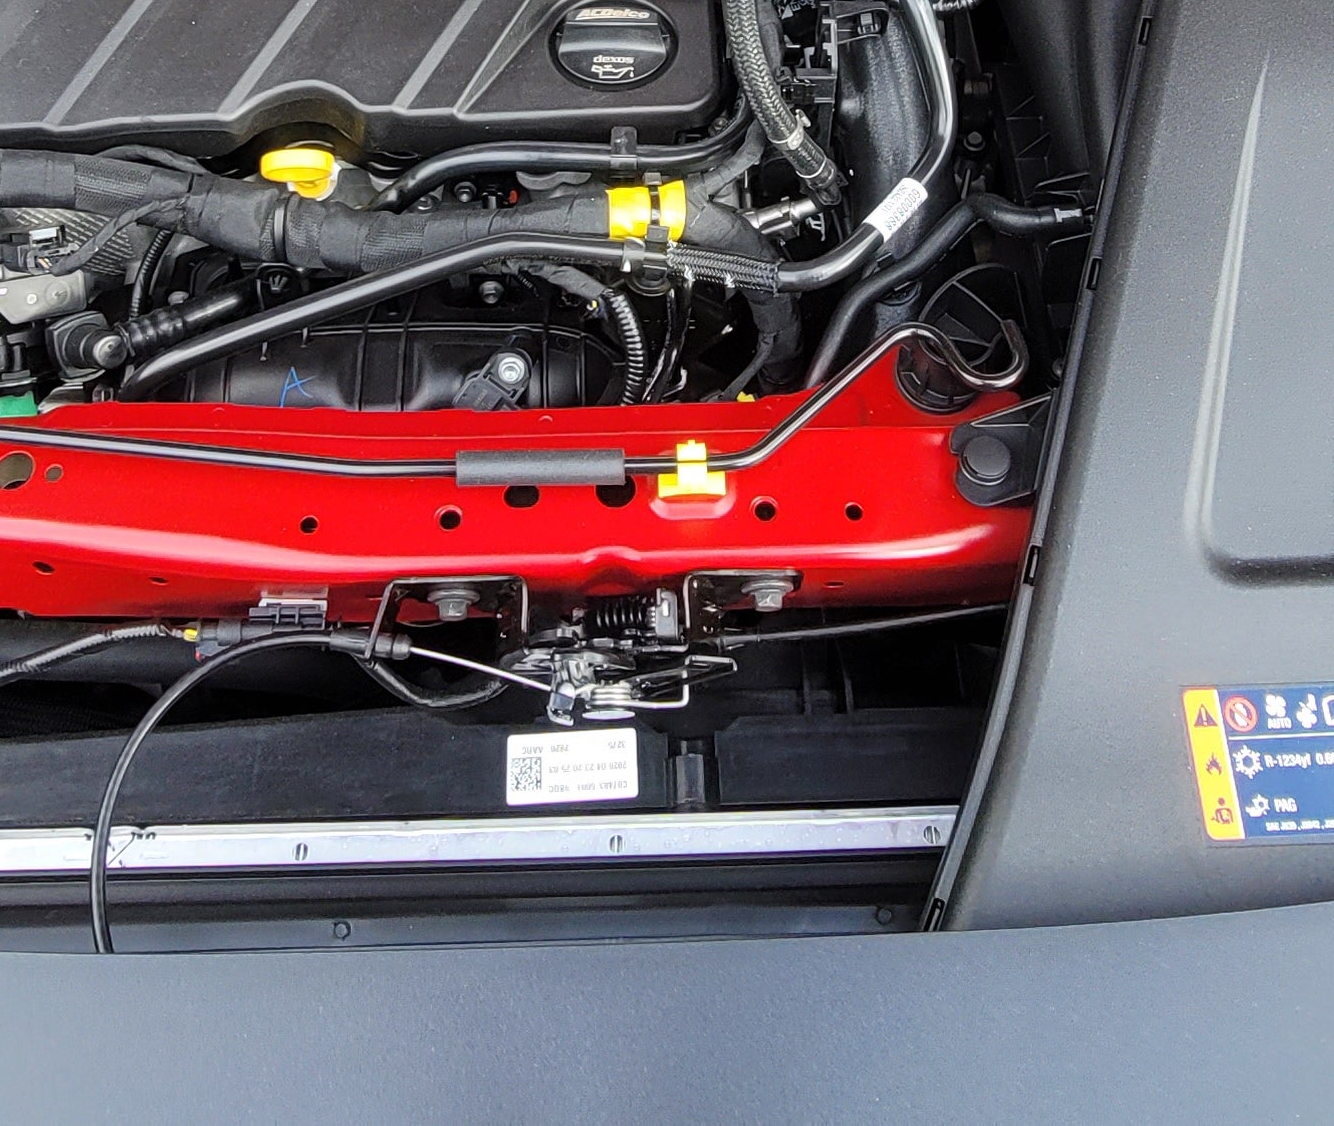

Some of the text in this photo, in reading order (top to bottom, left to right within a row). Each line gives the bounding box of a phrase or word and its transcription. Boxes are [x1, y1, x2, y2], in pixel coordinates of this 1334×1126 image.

[575, 7, 651, 21] ACDelco
[593, 54, 635, 65] dexos
[1273, 797, 1298, 813] PAG
